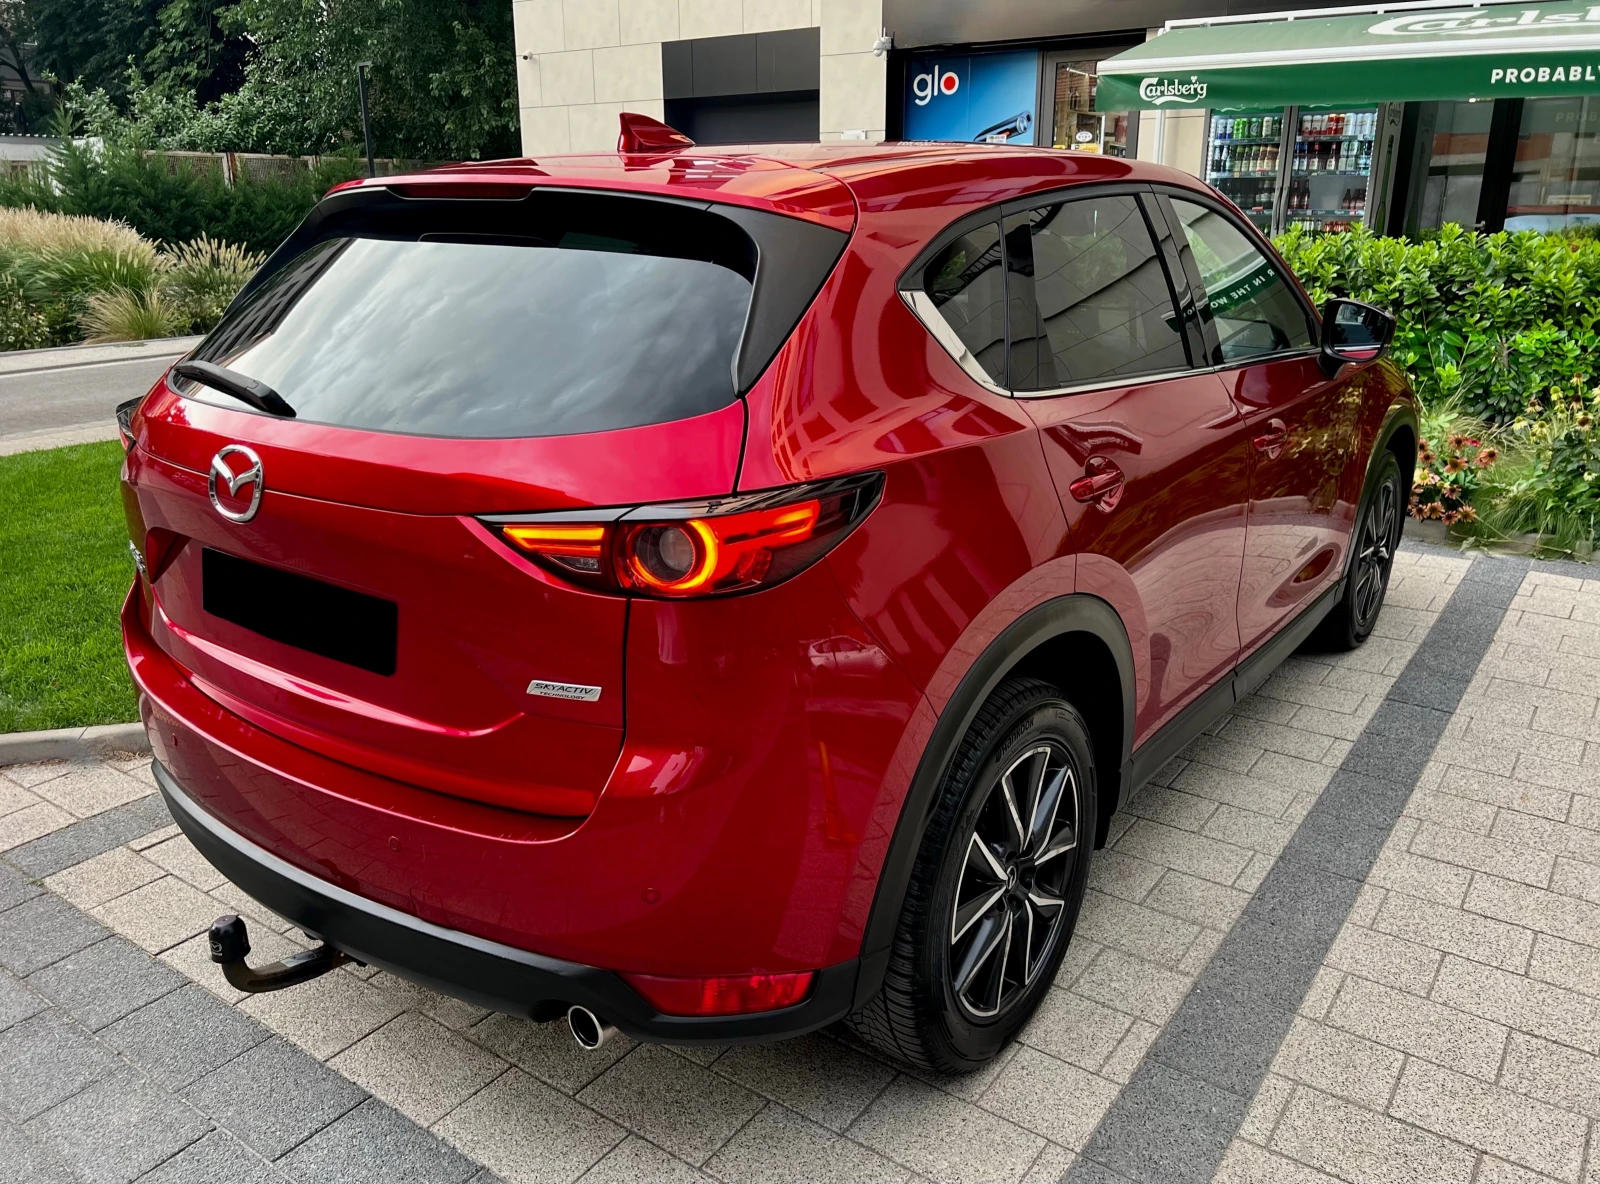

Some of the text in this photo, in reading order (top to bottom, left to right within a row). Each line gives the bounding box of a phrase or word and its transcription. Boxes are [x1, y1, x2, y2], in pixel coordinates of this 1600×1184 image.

[1491, 65, 1600, 83] PROBABL
[913, 64, 959, 106] glo
[1139, 76, 1208, 105] Carlsberg
[534, 682, 594, 694] SKYACTIV
[540, 691, 586, 700] TECHNOLOGY
